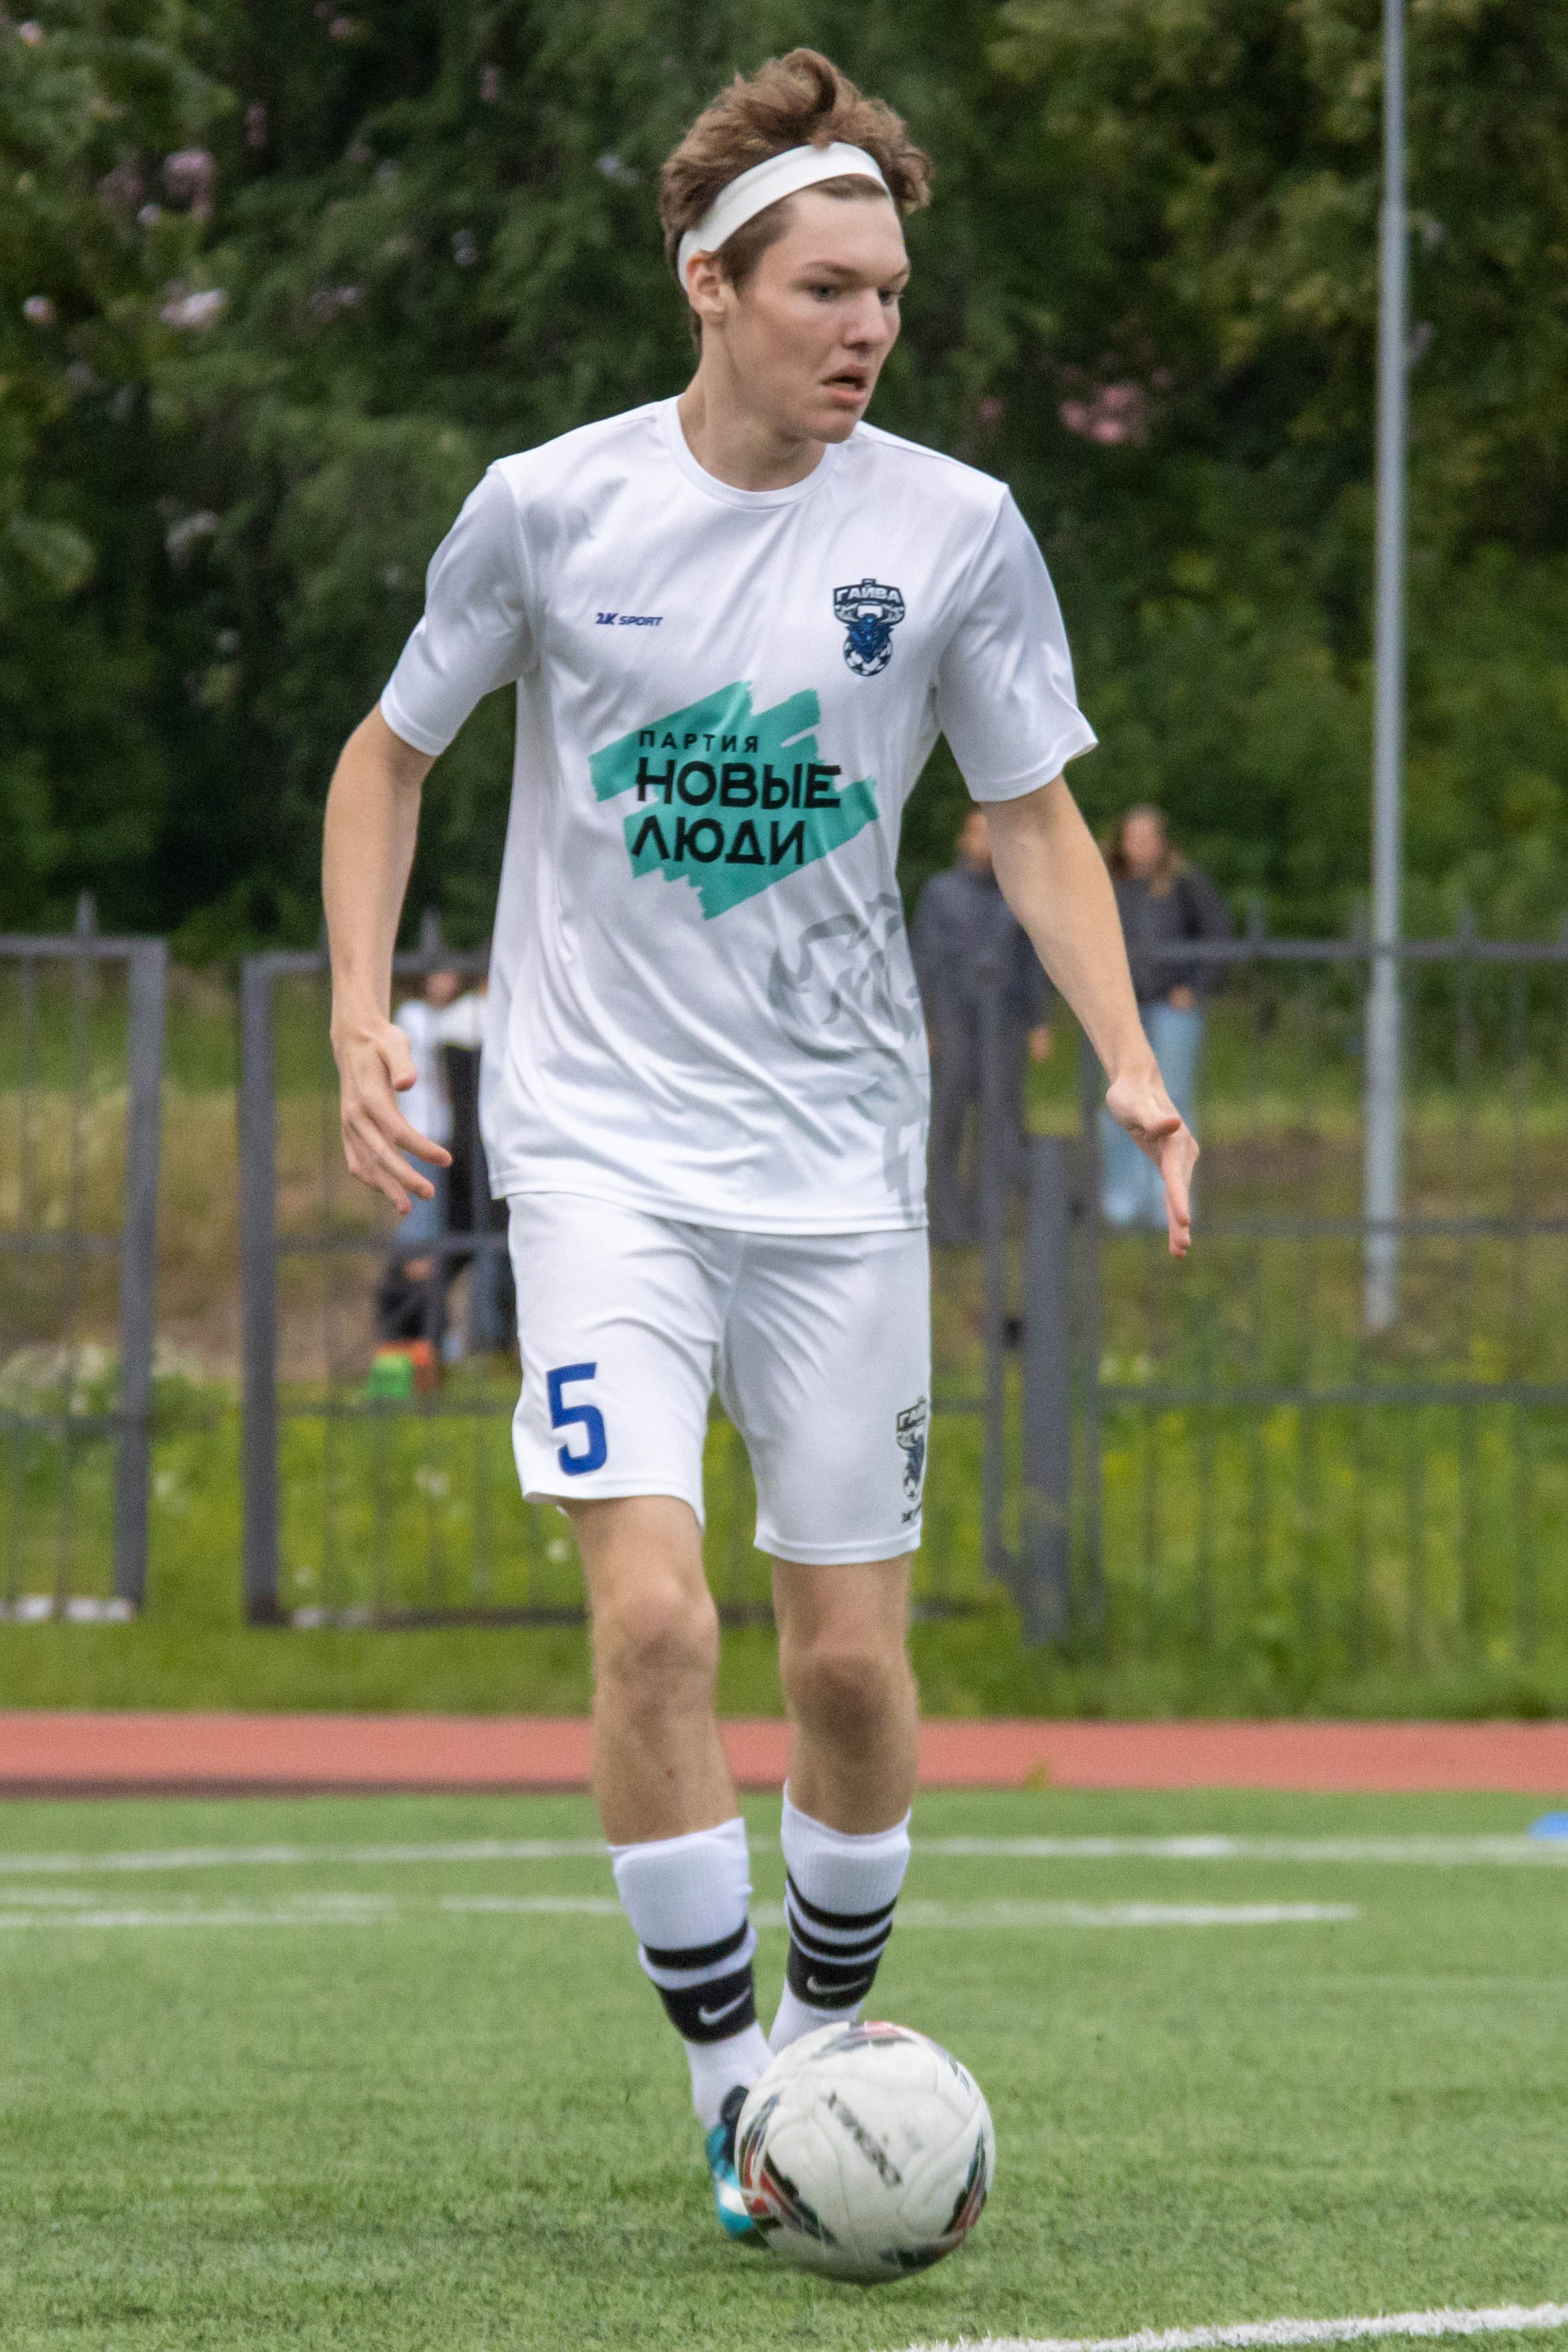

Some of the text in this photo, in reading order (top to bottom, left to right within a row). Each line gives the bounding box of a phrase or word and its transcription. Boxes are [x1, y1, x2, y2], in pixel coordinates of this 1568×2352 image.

[619, 616, 663, 626] SPORT
[638, 731, 758, 753] ПАРТИЯ
[636, 757, 841, 809] НОВЫЕ
[631, 815, 806, 865] ЛЮДИ
[546, 1362, 607, 1476] 5
